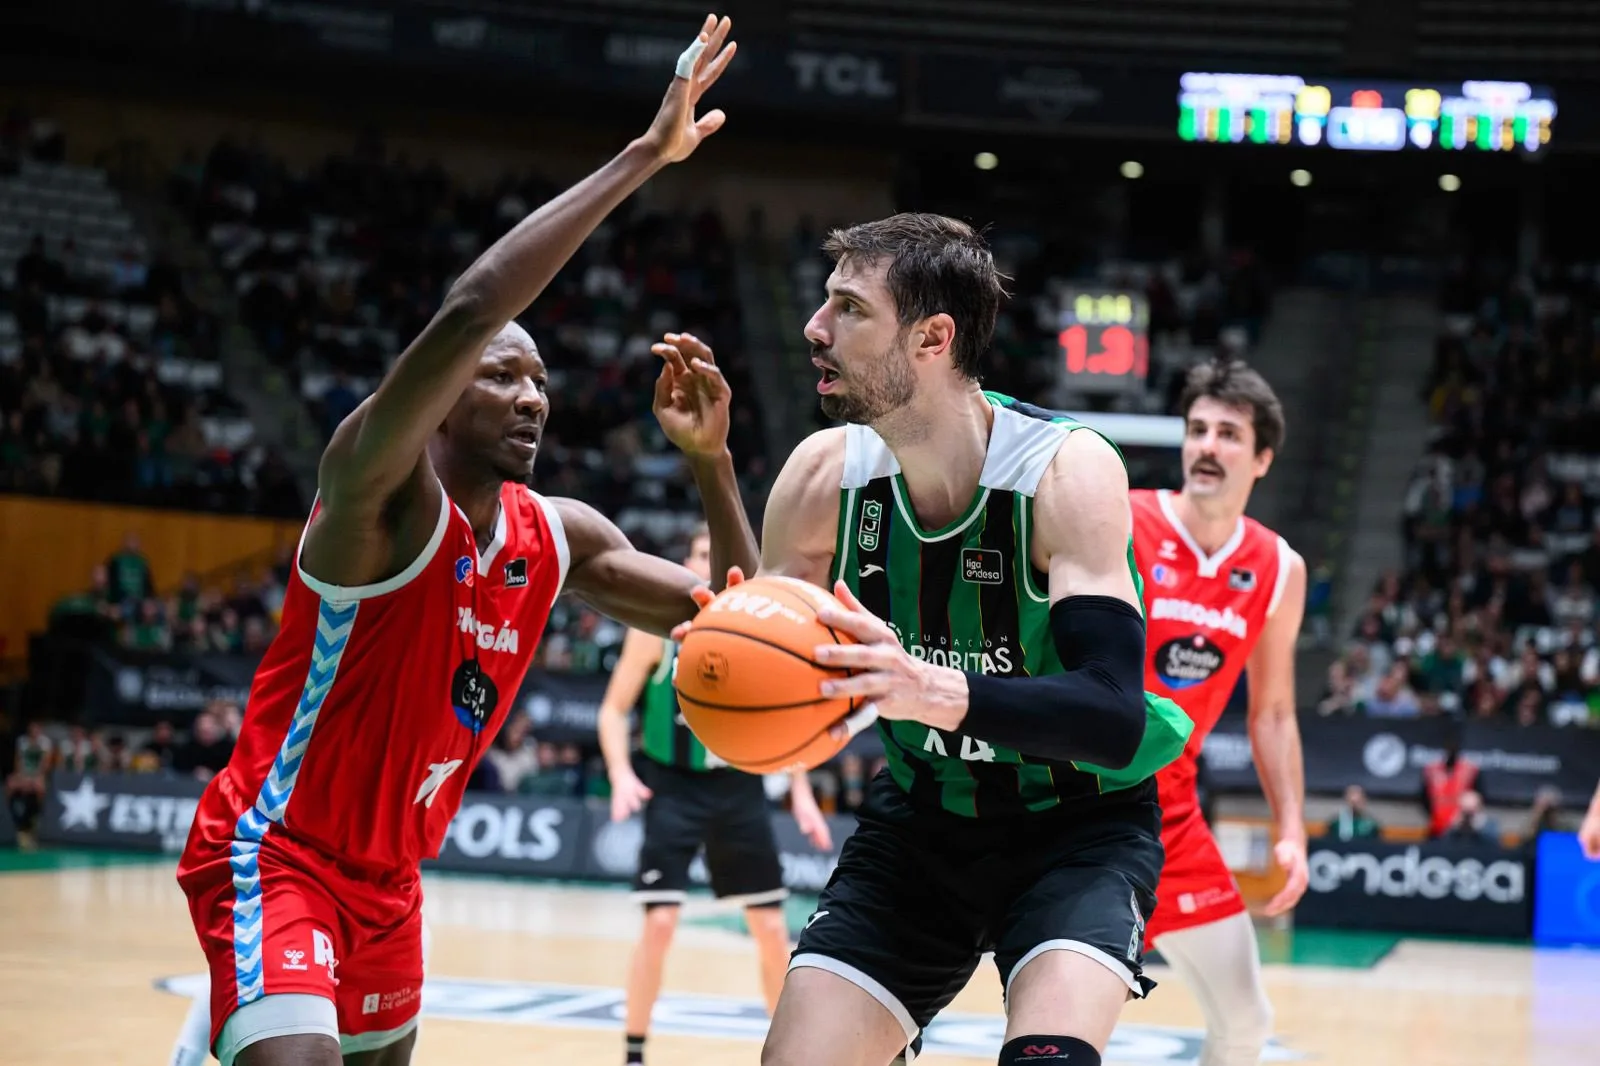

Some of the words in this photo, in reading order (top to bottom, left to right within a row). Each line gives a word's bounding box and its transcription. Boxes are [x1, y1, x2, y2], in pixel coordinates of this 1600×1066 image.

[788, 52, 897, 98] TCL
[966, 559, 981, 569] liga
[966, 569, 999, 580] endesa
[1308, 845, 1525, 903] endesa
